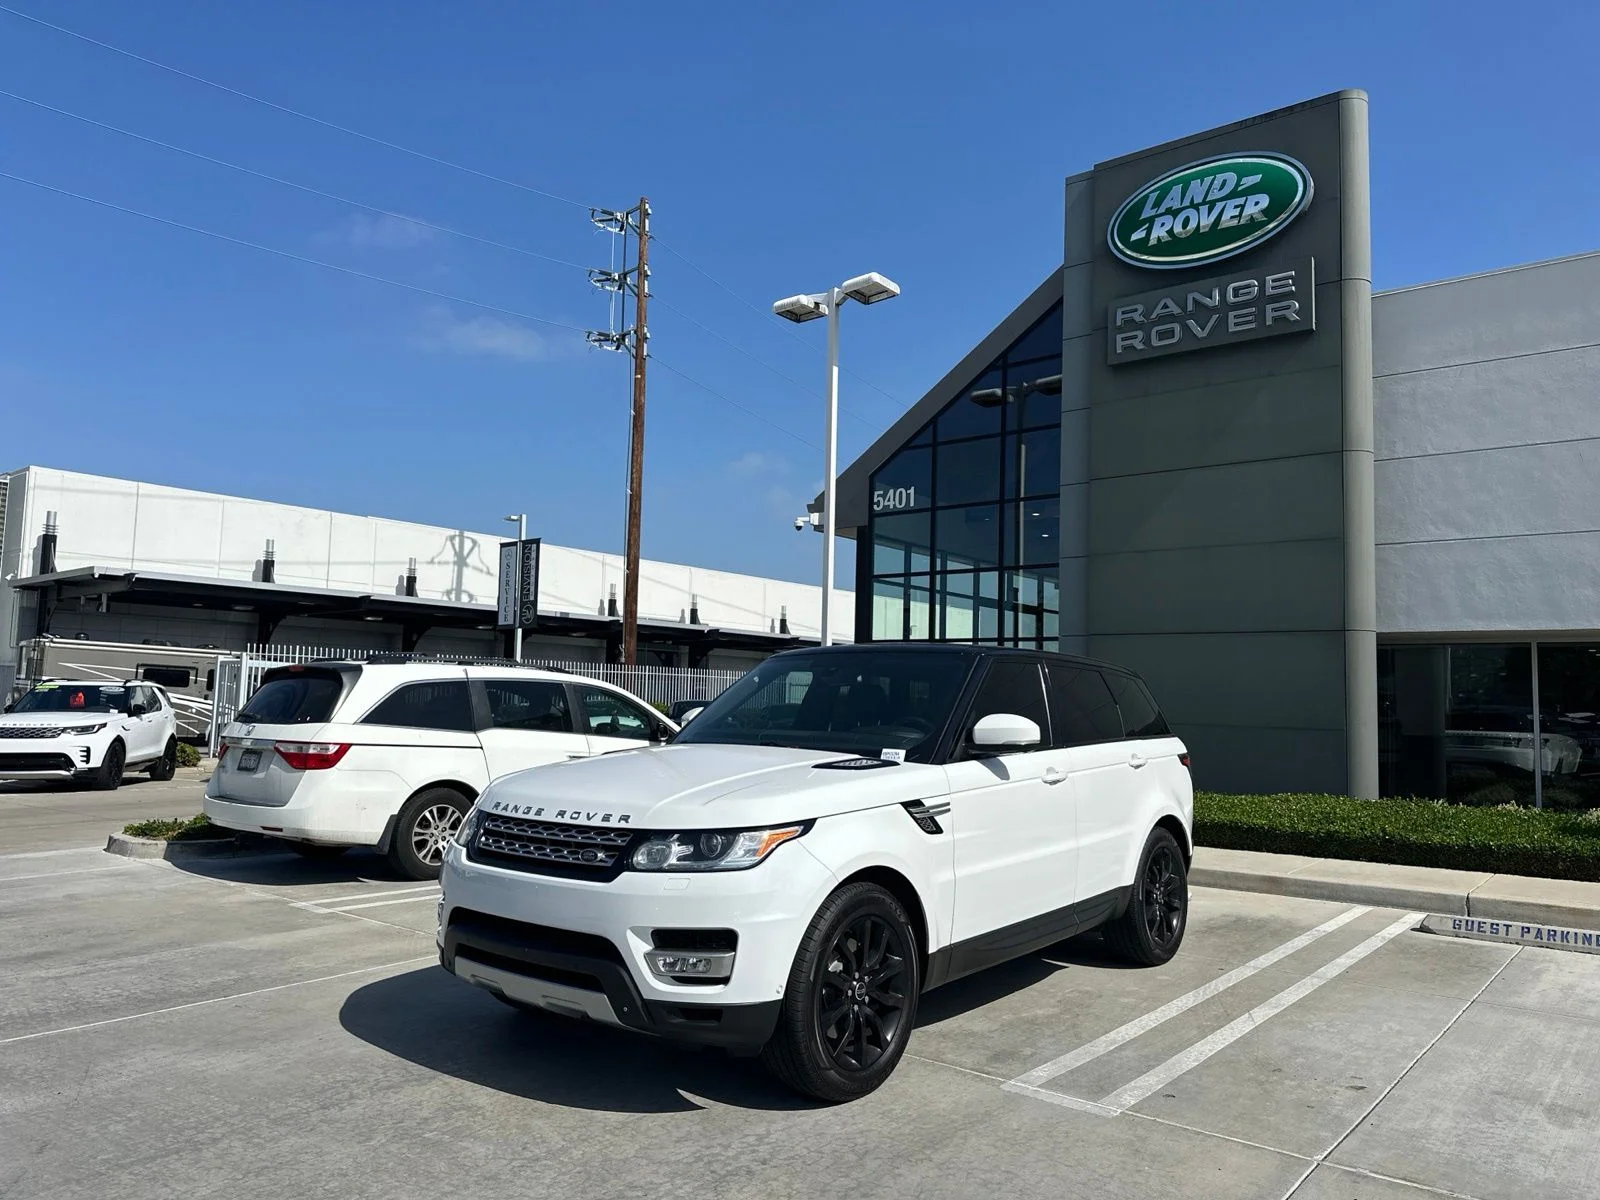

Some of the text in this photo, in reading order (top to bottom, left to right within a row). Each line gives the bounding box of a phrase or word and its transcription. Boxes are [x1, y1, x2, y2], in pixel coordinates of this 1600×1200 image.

[1139, 172, 1238, 220] LAND
[1147, 193, 1270, 246] ROVER
[1116, 270, 1296, 327] RANGE
[1116, 300, 1301, 354] ROVER
[873, 486, 915, 511] 5401
[522, 544, 532, 602] ENVISION
[491, 801, 631, 824] RANGE ROVER
[1452, 918, 1513, 937] GUEST
